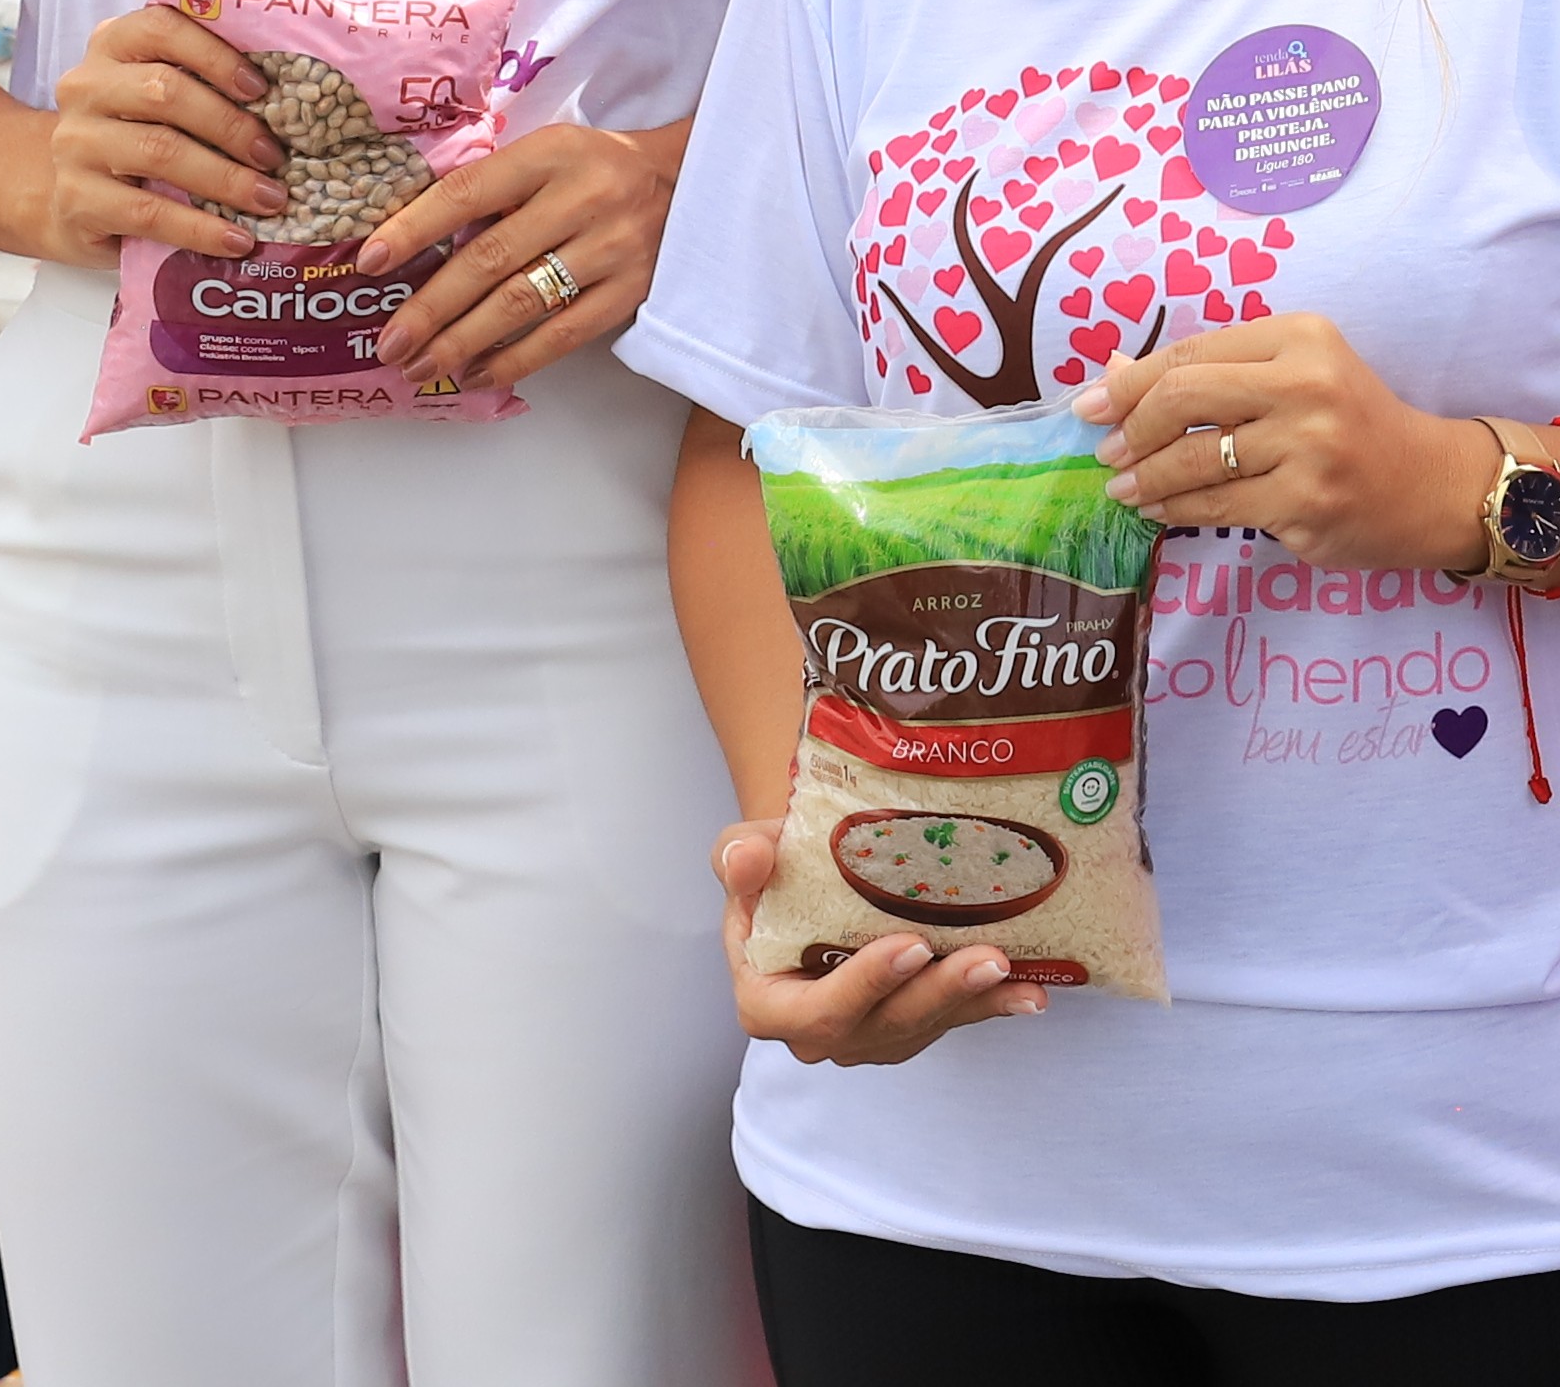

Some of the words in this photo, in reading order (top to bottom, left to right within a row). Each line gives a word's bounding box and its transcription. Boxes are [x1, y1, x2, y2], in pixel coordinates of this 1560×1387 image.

[347, 26, 471, 45] PRIME
[1255, 48, 1289, 65] tenda
[1255, 56, 1313, 80] LILÁS
[1206, 93, 1247, 113] NÃO
[1249, 85, 1308, 107] PASSE
[1310, 75, 1361, 97] PANO
[1198, 112, 1248, 131] PARA
[1250, 110, 1264, 124] A
[1265, 91, 1370, 121] VIOLÊNCIA.
[1238, 117, 1329, 143] PROTEJA.
[1235, 132, 1337, 162] DENUNCIE.
[1255, 158, 1289, 174] Ligue
[240, 259, 298, 281] feijão
[302, 261, 357, 282] prim
[191, 279, 415, 321] Carioca
[199, 334, 234, 345] grupo
[243, 337, 288, 346] comum
[240, 345, 272, 354] cores
[346, 335, 380, 360] 1k
[198, 387, 393, 406] PANTERA
[1151, 543, 1485, 617] cuidado,
[912, 593, 984, 612] ARROZ
[1066, 618, 1115, 634] PIRAHY
[808, 616, 980, 695] Prato
[975, 613, 1118, 696] Fino
[891, 737, 1015, 764] BRANCO
